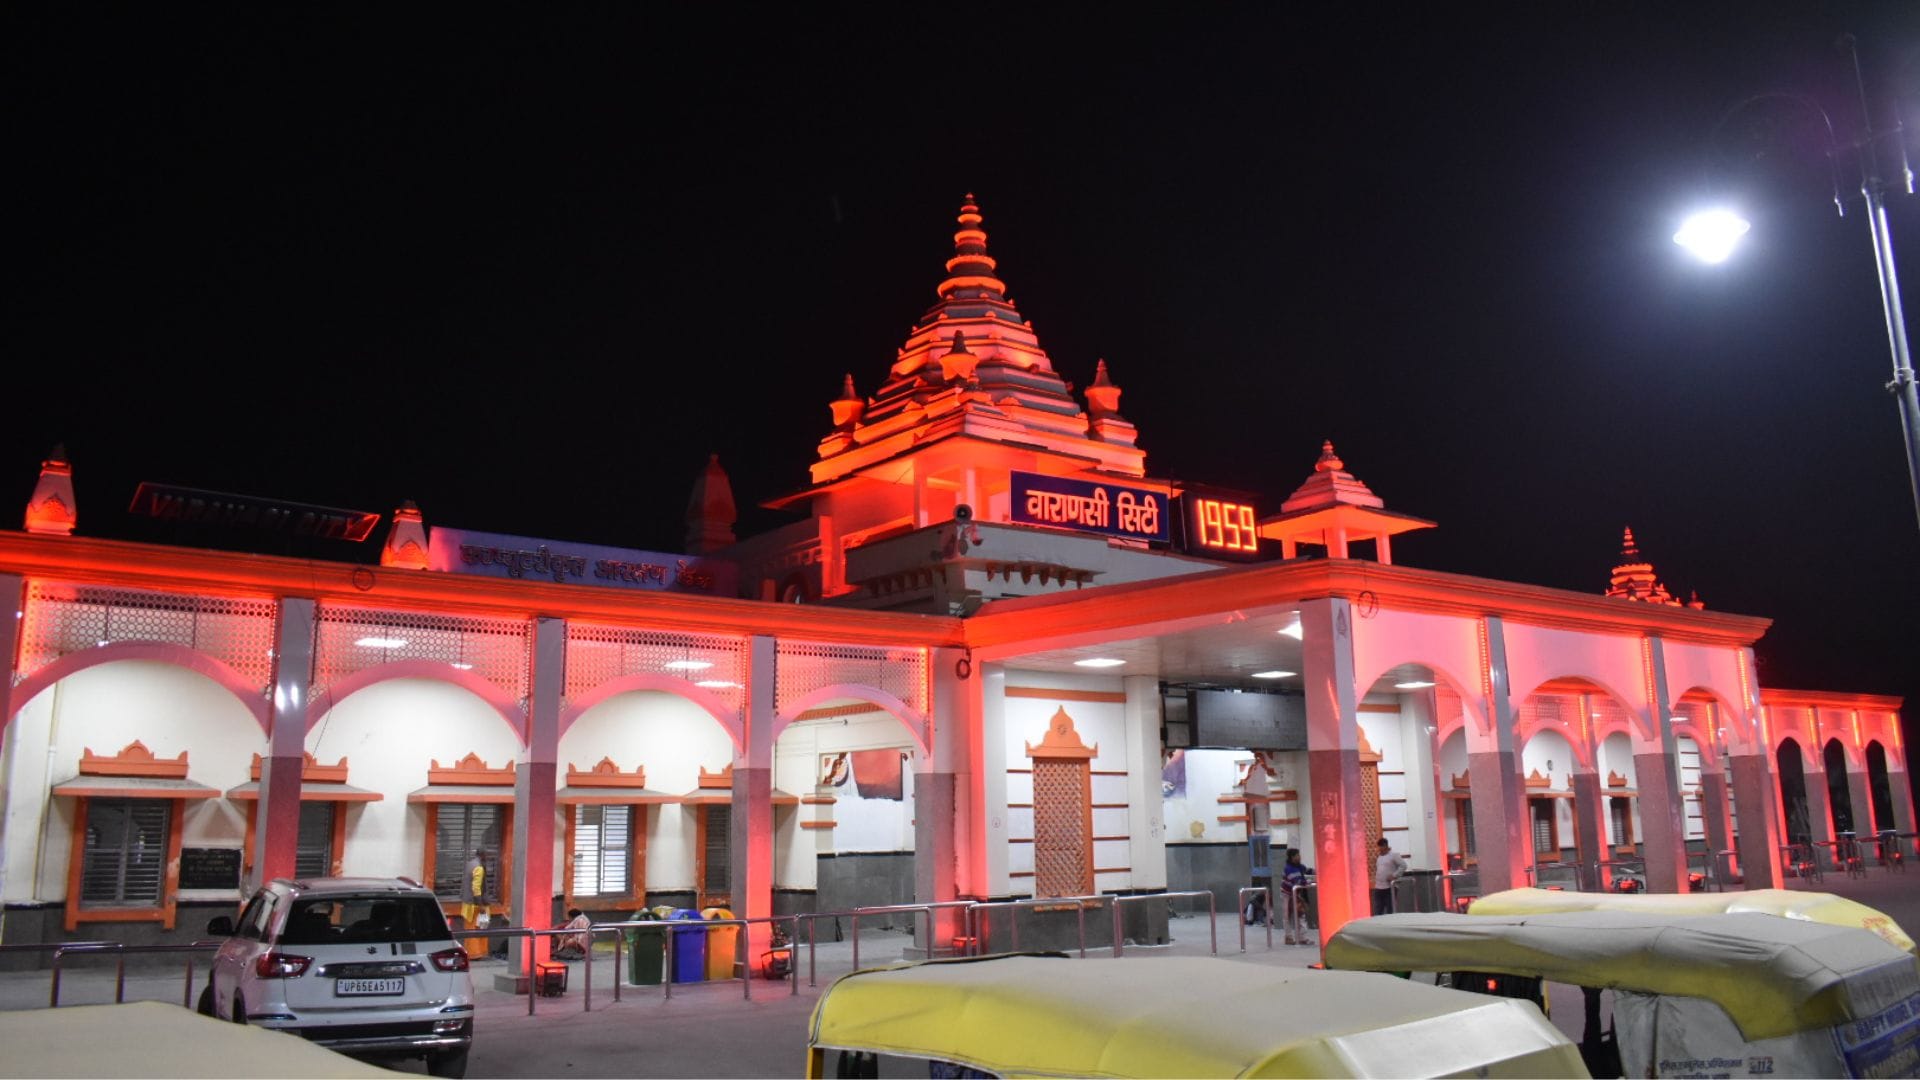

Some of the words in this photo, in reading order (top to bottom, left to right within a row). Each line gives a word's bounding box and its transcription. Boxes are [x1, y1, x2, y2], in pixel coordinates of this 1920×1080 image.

[150, 493, 292, 531] VARANSI
[1025, 487, 1110, 528] वाराणसी
[1116, 491, 1159, 534] सिटी
[1197, 498, 1258, 551] 1959
[593, 558, 668, 585] आरक्षण
[344, 981, 403, 992] UP65EA5117
